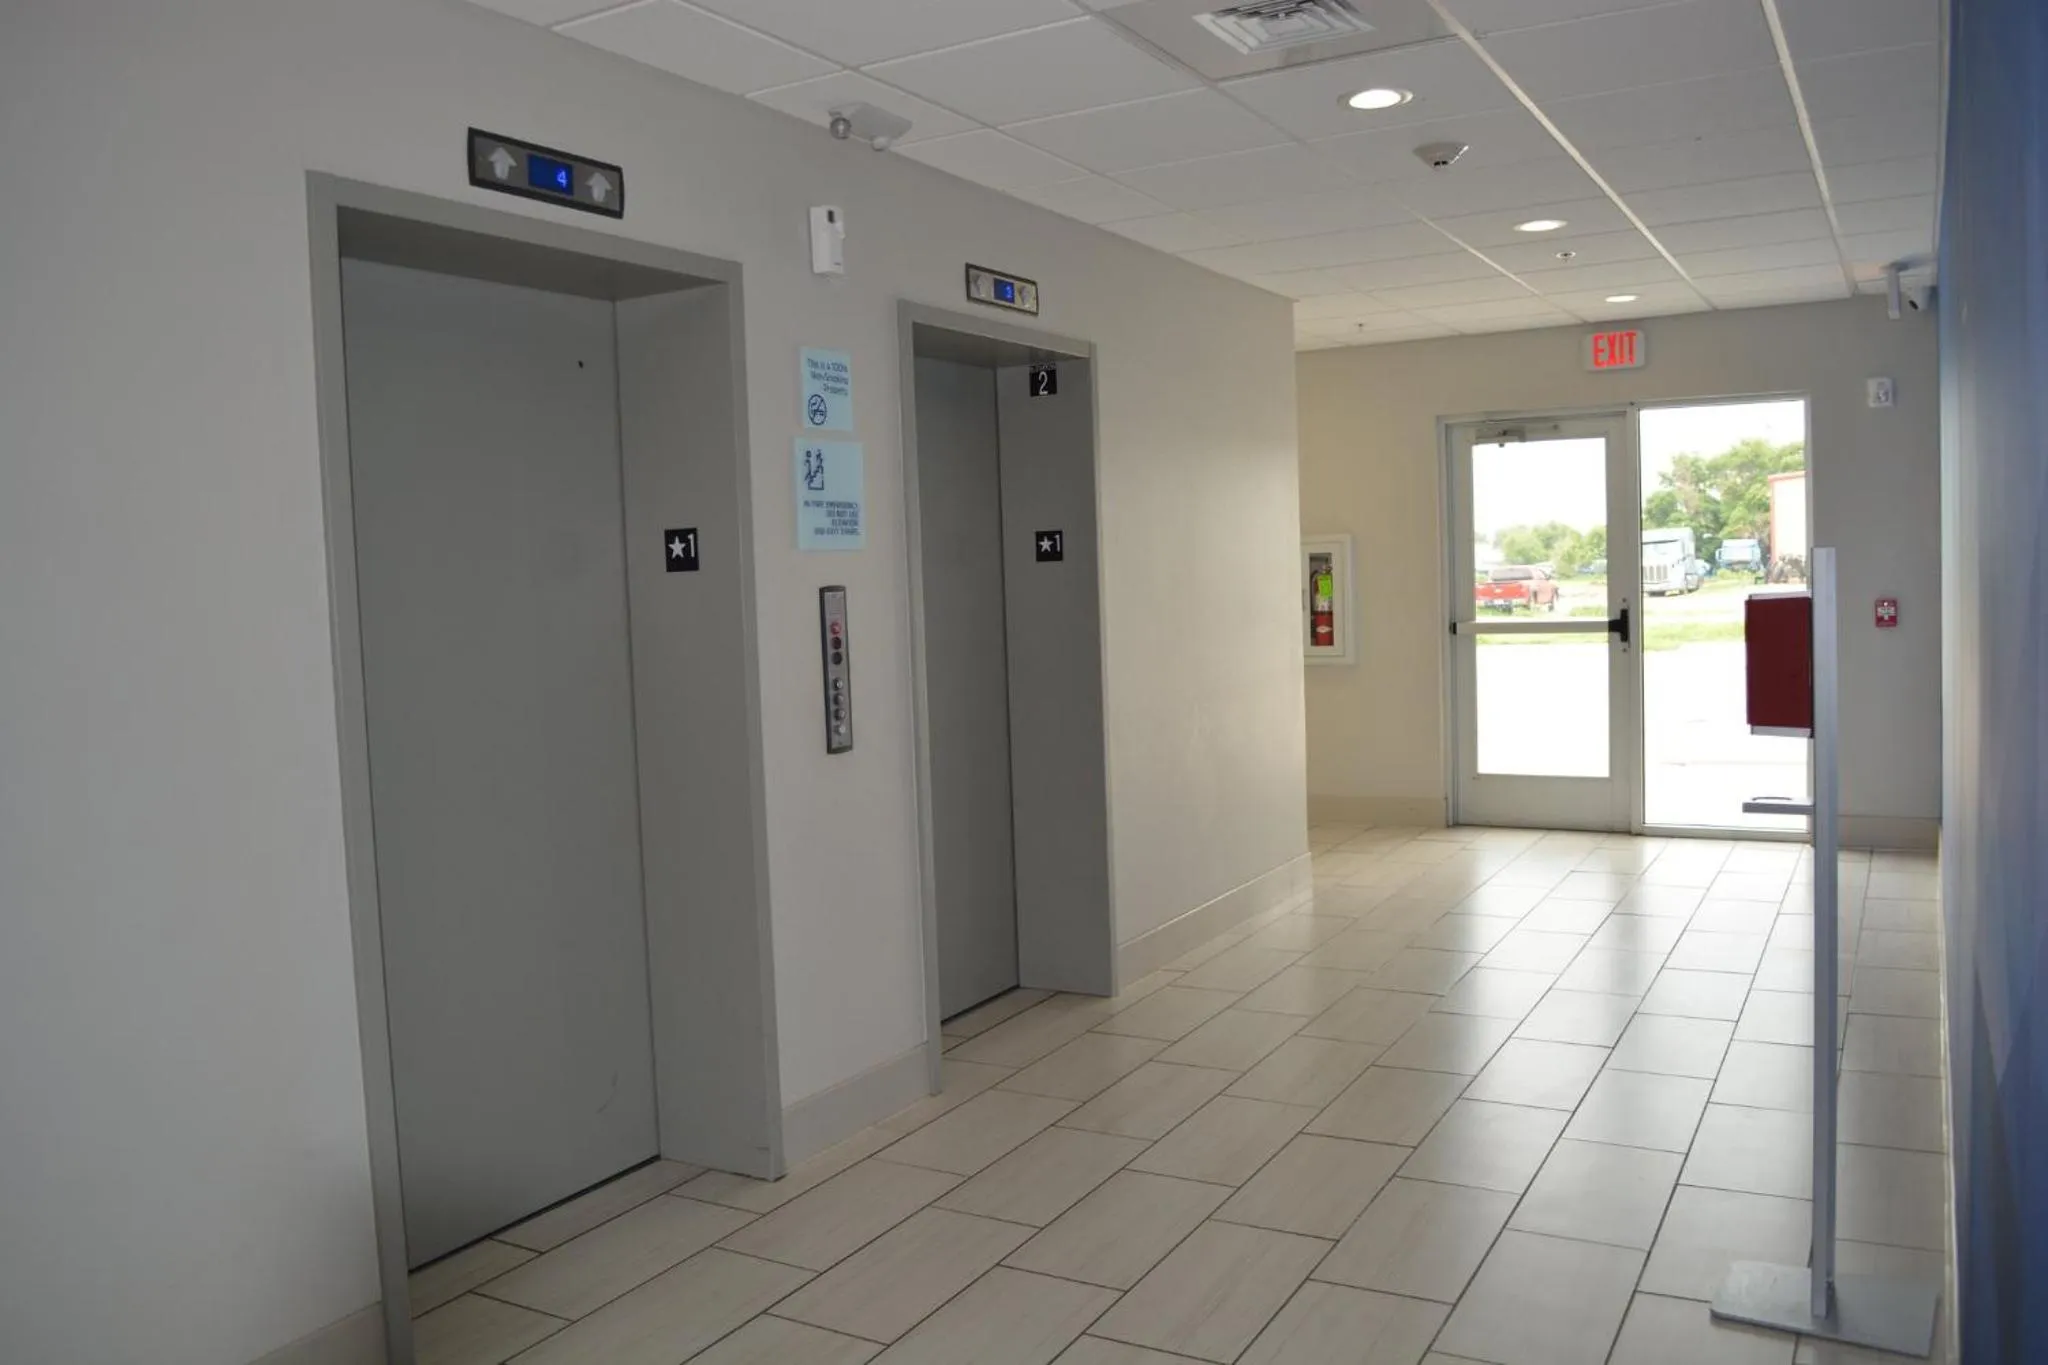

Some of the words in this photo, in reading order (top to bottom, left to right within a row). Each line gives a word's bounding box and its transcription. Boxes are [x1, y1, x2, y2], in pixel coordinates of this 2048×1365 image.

[556, 169, 567, 189] 4
[1593, 331, 1637, 369] EXIT
[1038, 371, 1048, 396] 2
[687, 533, 695, 558] 1
[1054, 534, 1061, 553] 1
